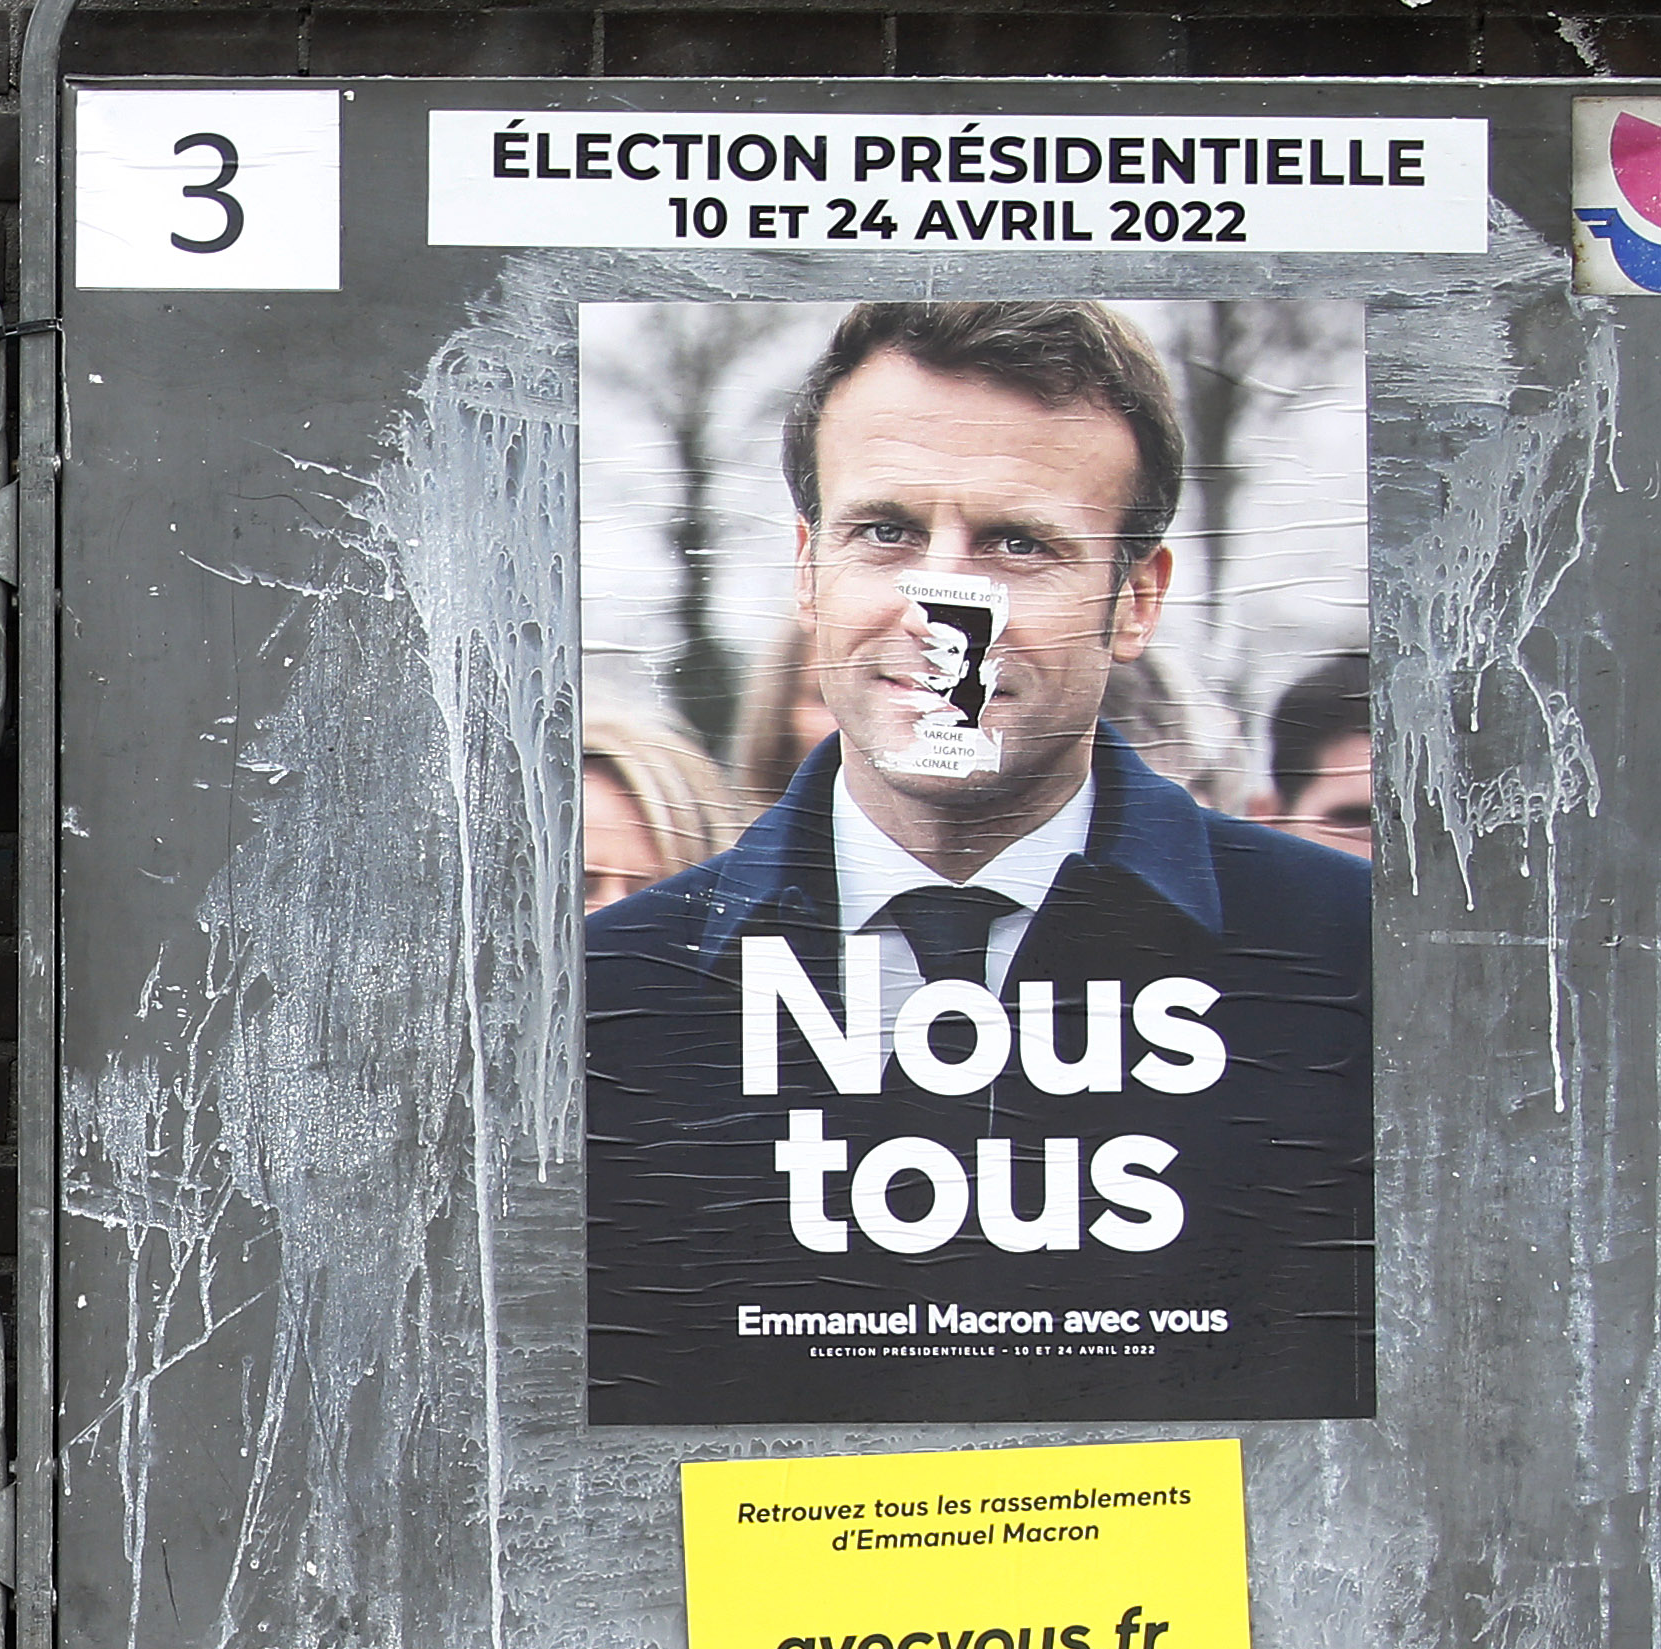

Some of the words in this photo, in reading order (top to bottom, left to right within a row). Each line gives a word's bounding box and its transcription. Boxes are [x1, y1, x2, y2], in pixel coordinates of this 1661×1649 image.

[493, 118, 827, 182] ÉLECTION
[854, 122, 1425, 187] PRÉSIDENTIELLE
[170, 132, 245, 254] 3
[668, 196, 728, 239] 10
[749, 204, 810, 239] ET
[826, 198, 898, 240] 24
[914, 199, 1093, 241] AVRIL
[1109, 200, 1247, 243] 2022
[894, 585, 977, 601] RÉSIDENTIELLE
[979, 594, 1003, 603] 202
[740, 935, 1227, 1096] Nous
[774, 1109, 1184, 1254] tous
[738, 1304, 917, 1336] Emmanuel
[928, 1303, 1054, 1334] Macron
[1063, 1310, 1141, 1333] avec
[1148, 1309, 1228, 1333] vous
[810, 1347, 876, 1357] ÉLECTION
[883, 1346, 995, 1356] PRÉSIDENTIELLE
[1014, 1346, 1029, 1356] 10
[1035, 1346, 1051, 1356] ET
[1058, 1346, 1073, 1355] 24
[1079, 1345, 1117, 1355] AVRIL
[1124, 1345, 1155, 1355] 2022
[738, 1502, 866, 1524] Retrouvez
[874, 1499, 929, 1518] tous
[937, 1494, 972, 1516] les
[980, 1486, 1191, 1514] rassemblements
[831, 1523, 994, 1552] d'Emmanuel
[1003, 1522, 1099, 1544] Macron
